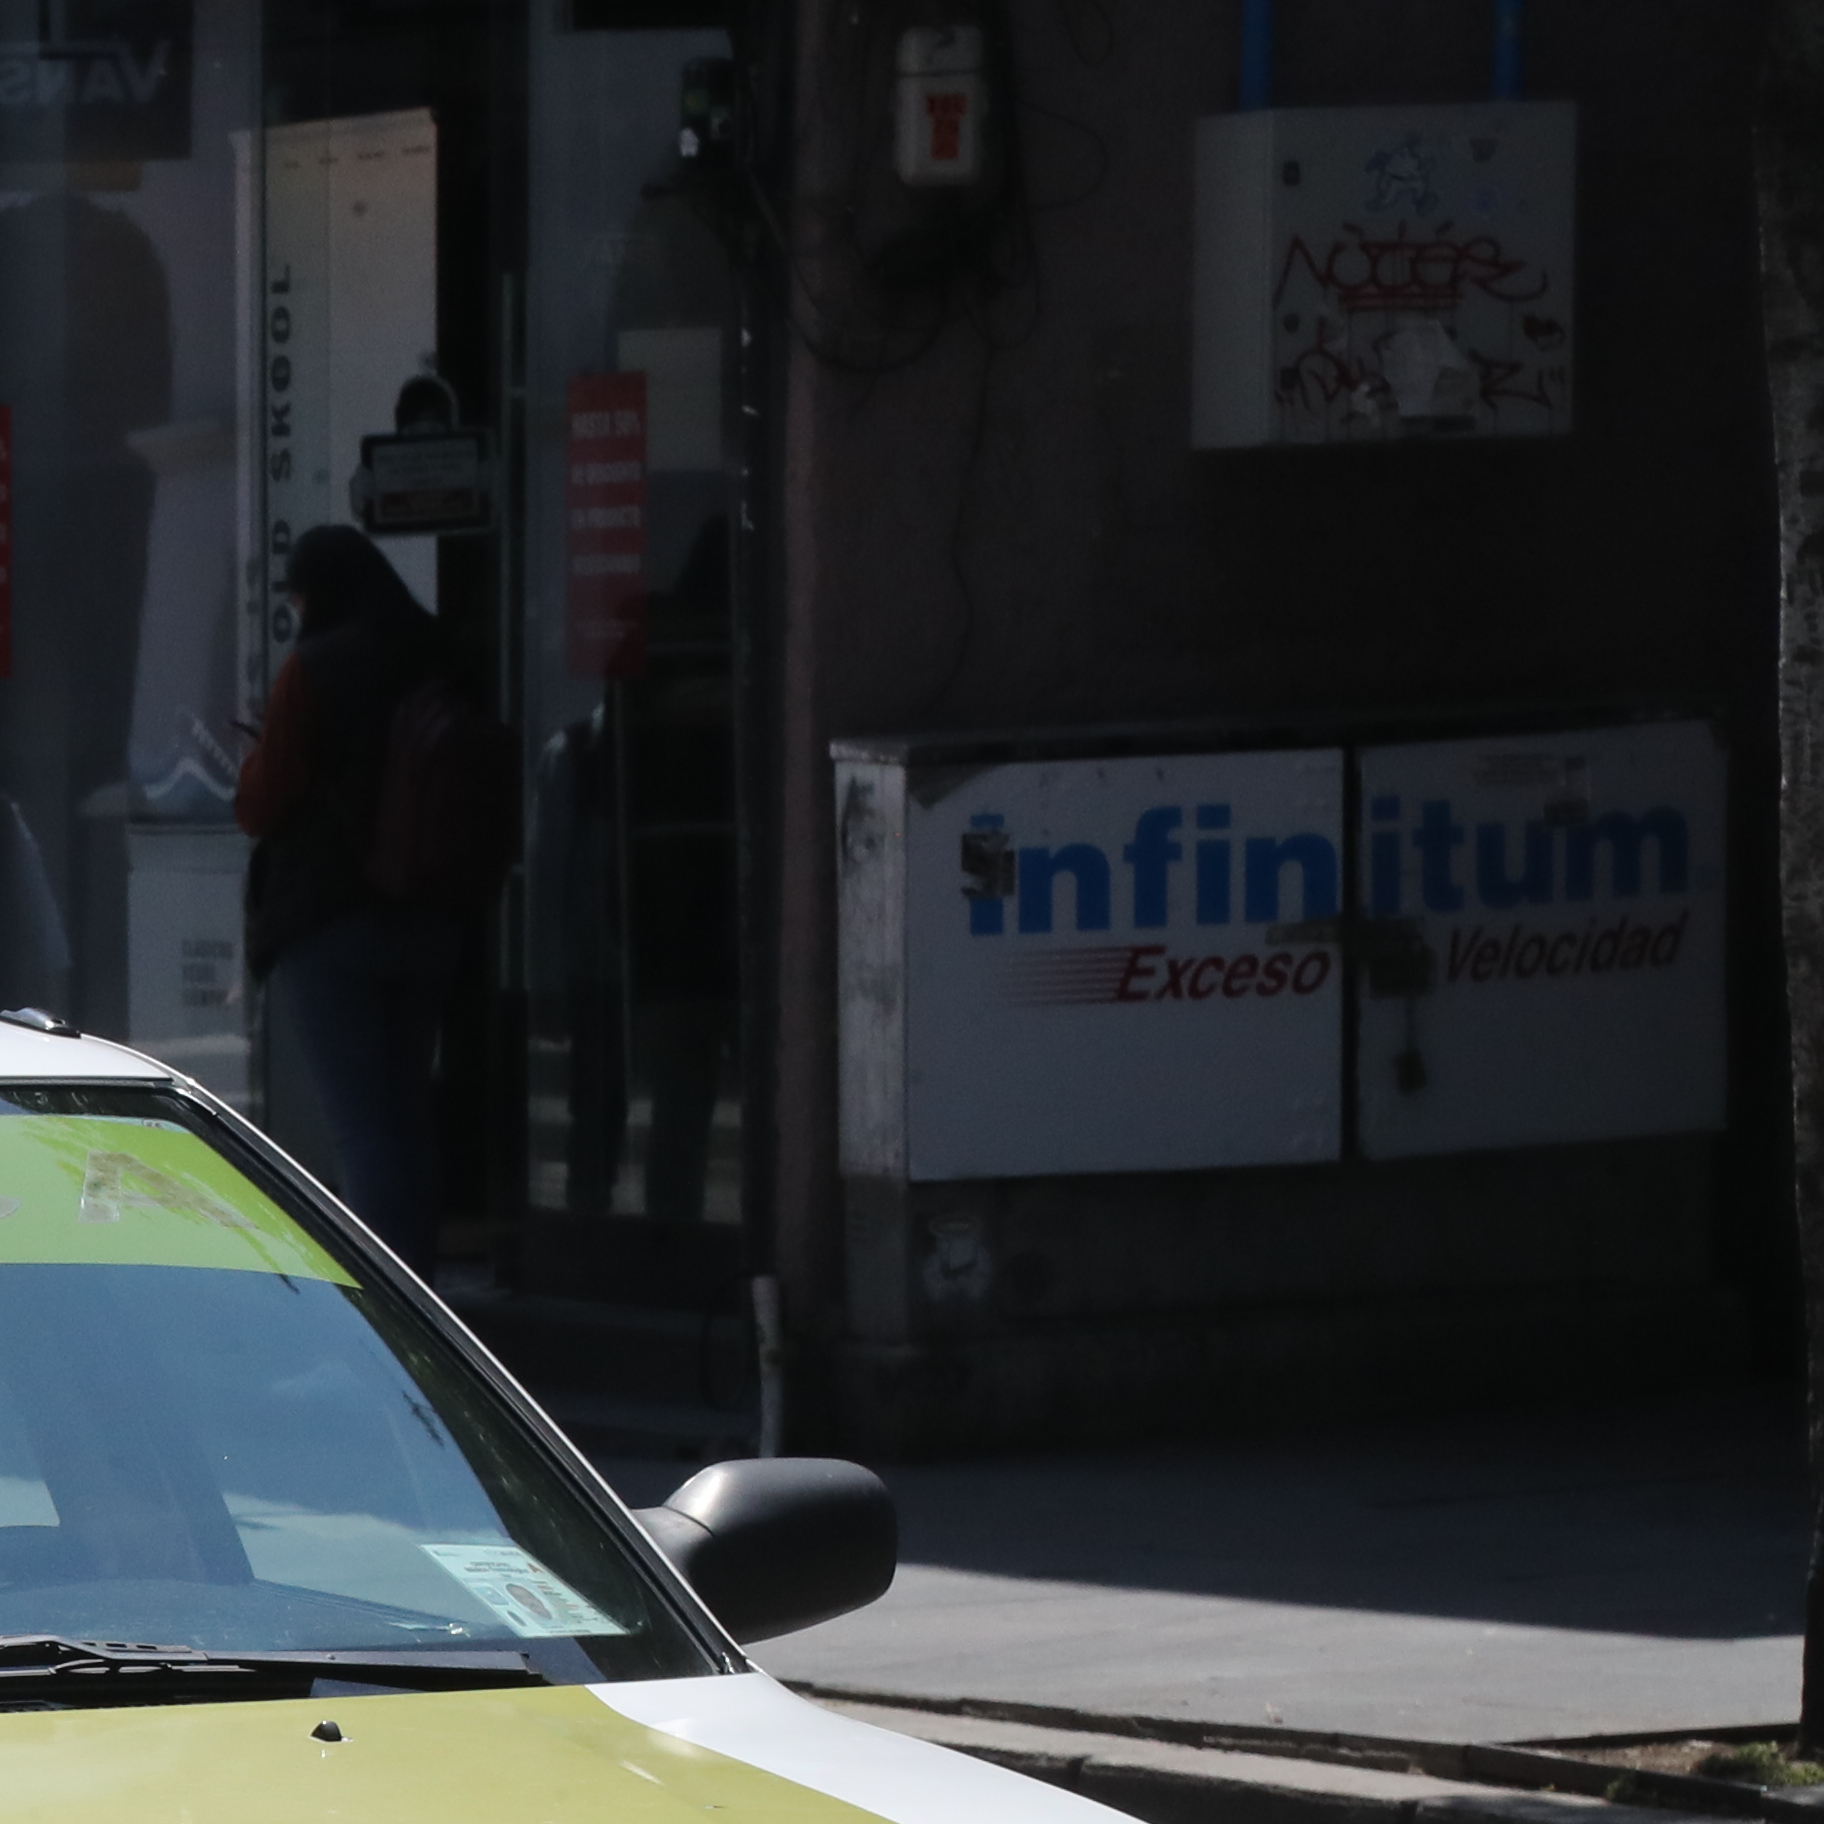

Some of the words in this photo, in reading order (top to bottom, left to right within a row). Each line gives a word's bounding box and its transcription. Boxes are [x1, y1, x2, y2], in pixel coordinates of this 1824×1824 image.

[269, 262, 293, 483] SKOOL
[1114, 944, 1332, 1002] Exceso
[1447, 907, 1690, 985] Velocidad
